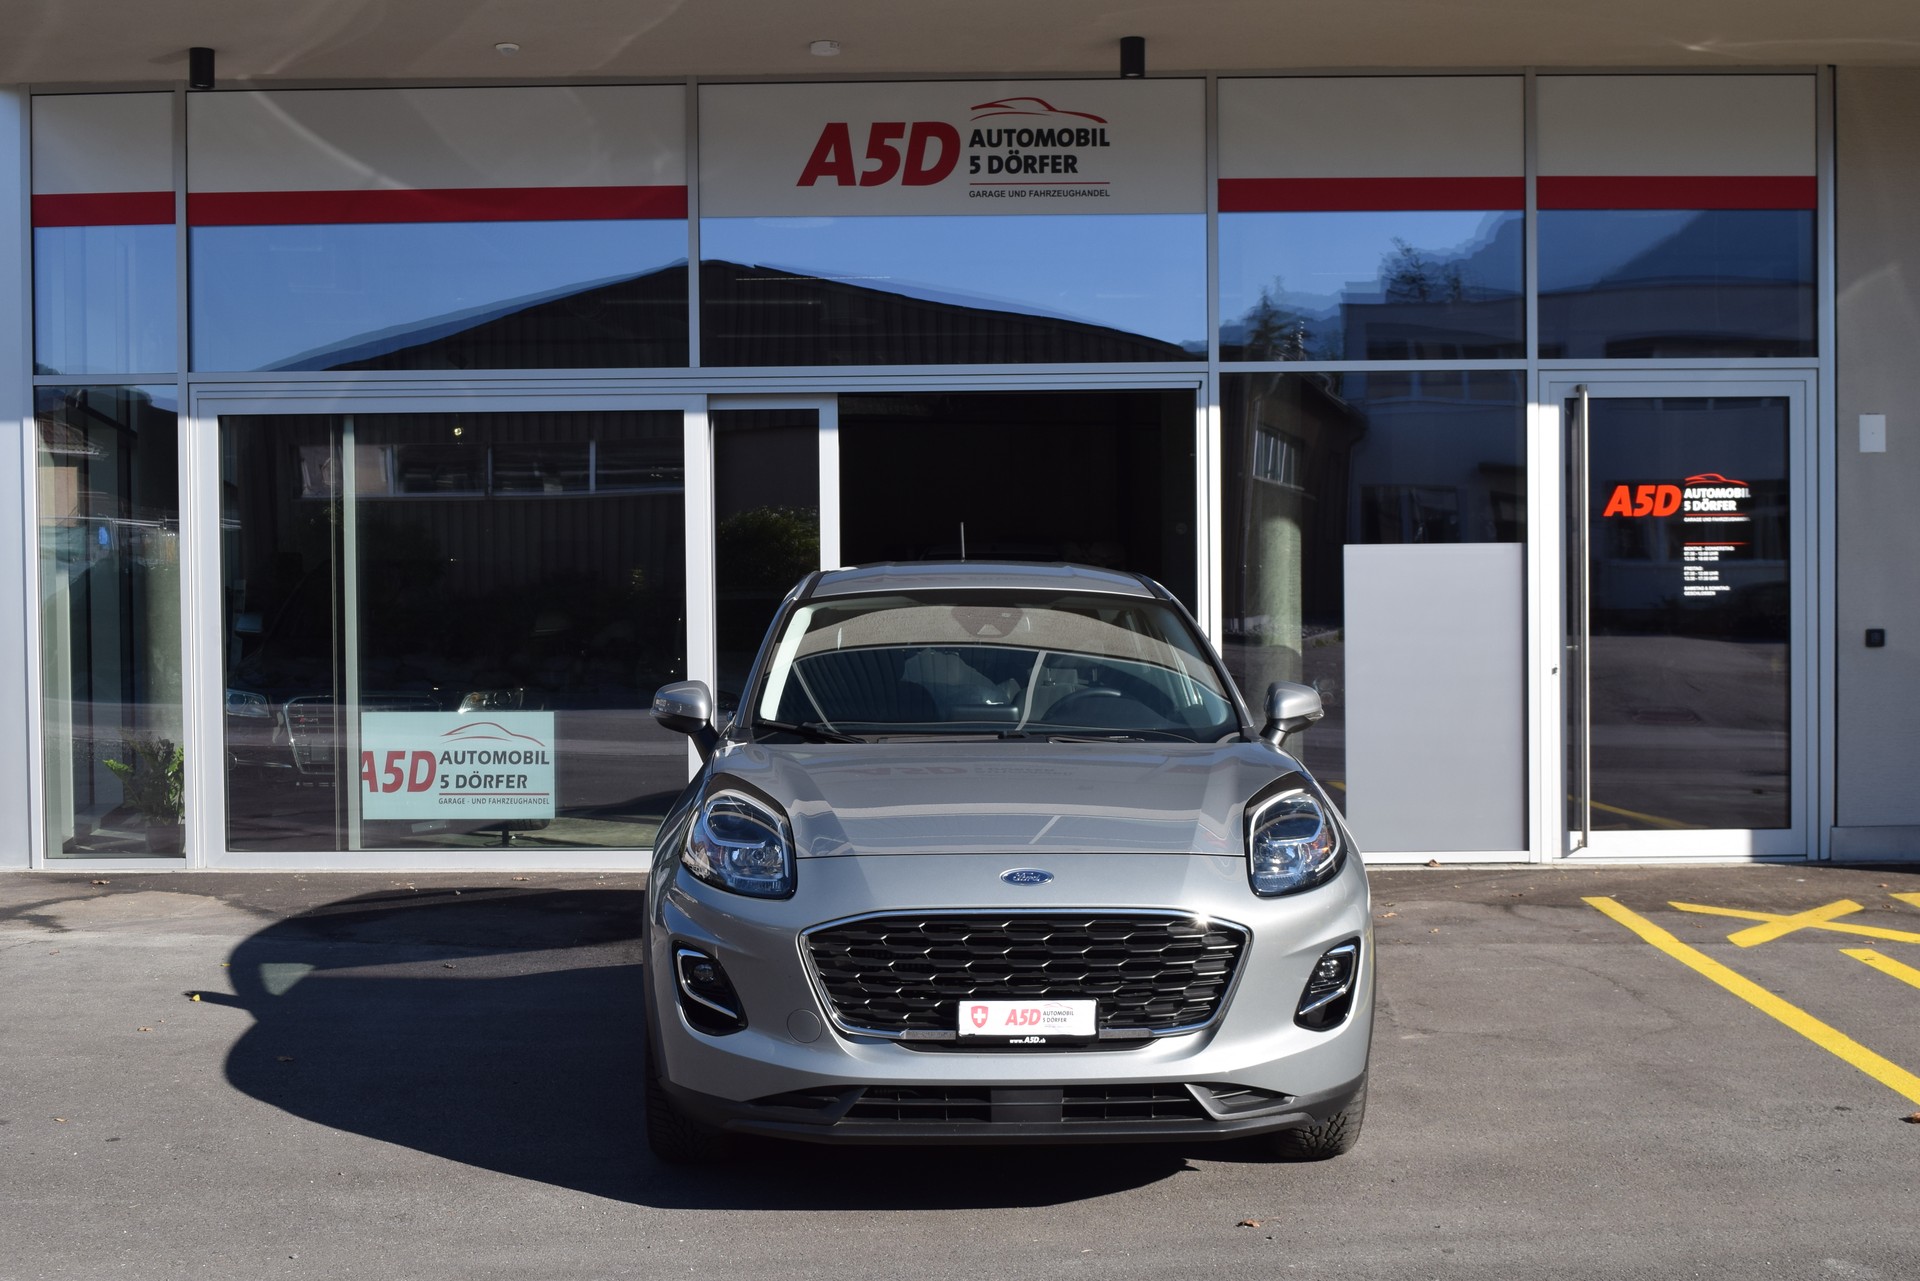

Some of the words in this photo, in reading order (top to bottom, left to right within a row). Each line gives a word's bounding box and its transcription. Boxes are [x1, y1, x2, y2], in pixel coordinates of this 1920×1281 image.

[969, 128, 1110, 148] AUTOMOBIL
[796, 121, 961, 187] A5D
[969, 155, 981, 174] 5
[988, 150, 1078, 174] DÖRFER
[969, 190, 1006, 198] GARAGE
[1008, 190, 1027, 198] UND
[1028, 189, 1110, 197] FAHRZEUGHANDEL
[1602, 485, 1682, 517] A5D
[1683, 488, 1751, 499] AUTOMOBIL
[1683, 500, 1692, 511] 5
[1693, 498, 1737, 512] DÖRFER
[439, 750, 550, 765] AUTOMOBIL
[361, 751, 437, 793] A5D
[440, 775, 449, 789] 5
[456, 771, 527, 789] DÖRFER
[438, 797, 465, 805] GARAGE
[472, 797, 487, 805] UND
[488, 797, 550, 805] FAHRZEUGHANDEL
[1004, 1008, 1041, 1026] A5D
